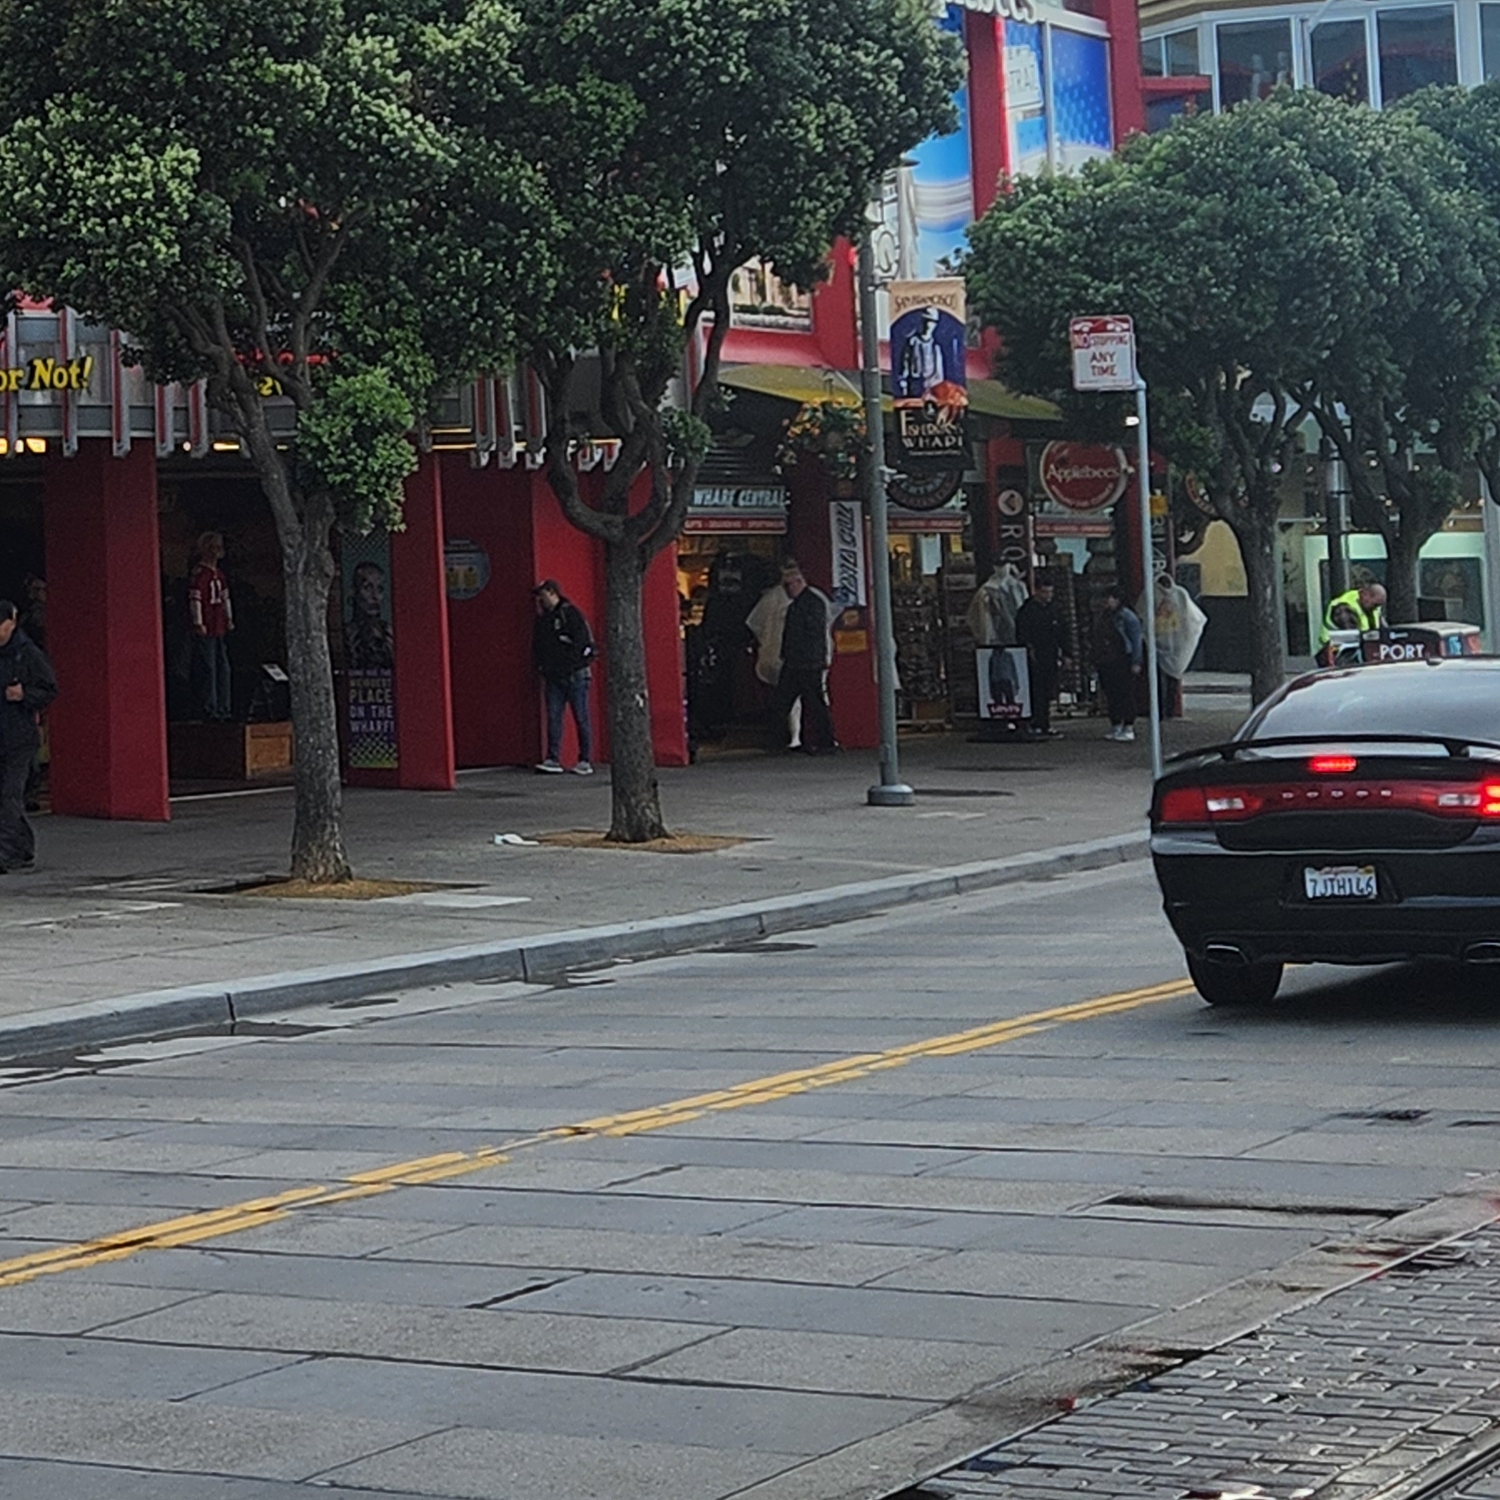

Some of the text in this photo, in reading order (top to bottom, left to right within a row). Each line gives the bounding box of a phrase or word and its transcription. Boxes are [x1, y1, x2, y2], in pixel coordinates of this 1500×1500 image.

[1090, 351, 1116, 363] ANY
[31, 356, 93, 391] Not!
[1091, 364, 1117, 377] TIME
[1380, 643, 1425, 660] PORT
[349, 689, 392, 703] PLACE
[350, 704, 394, 718] ON THE
[350, 720, 395, 733] WHARF!
